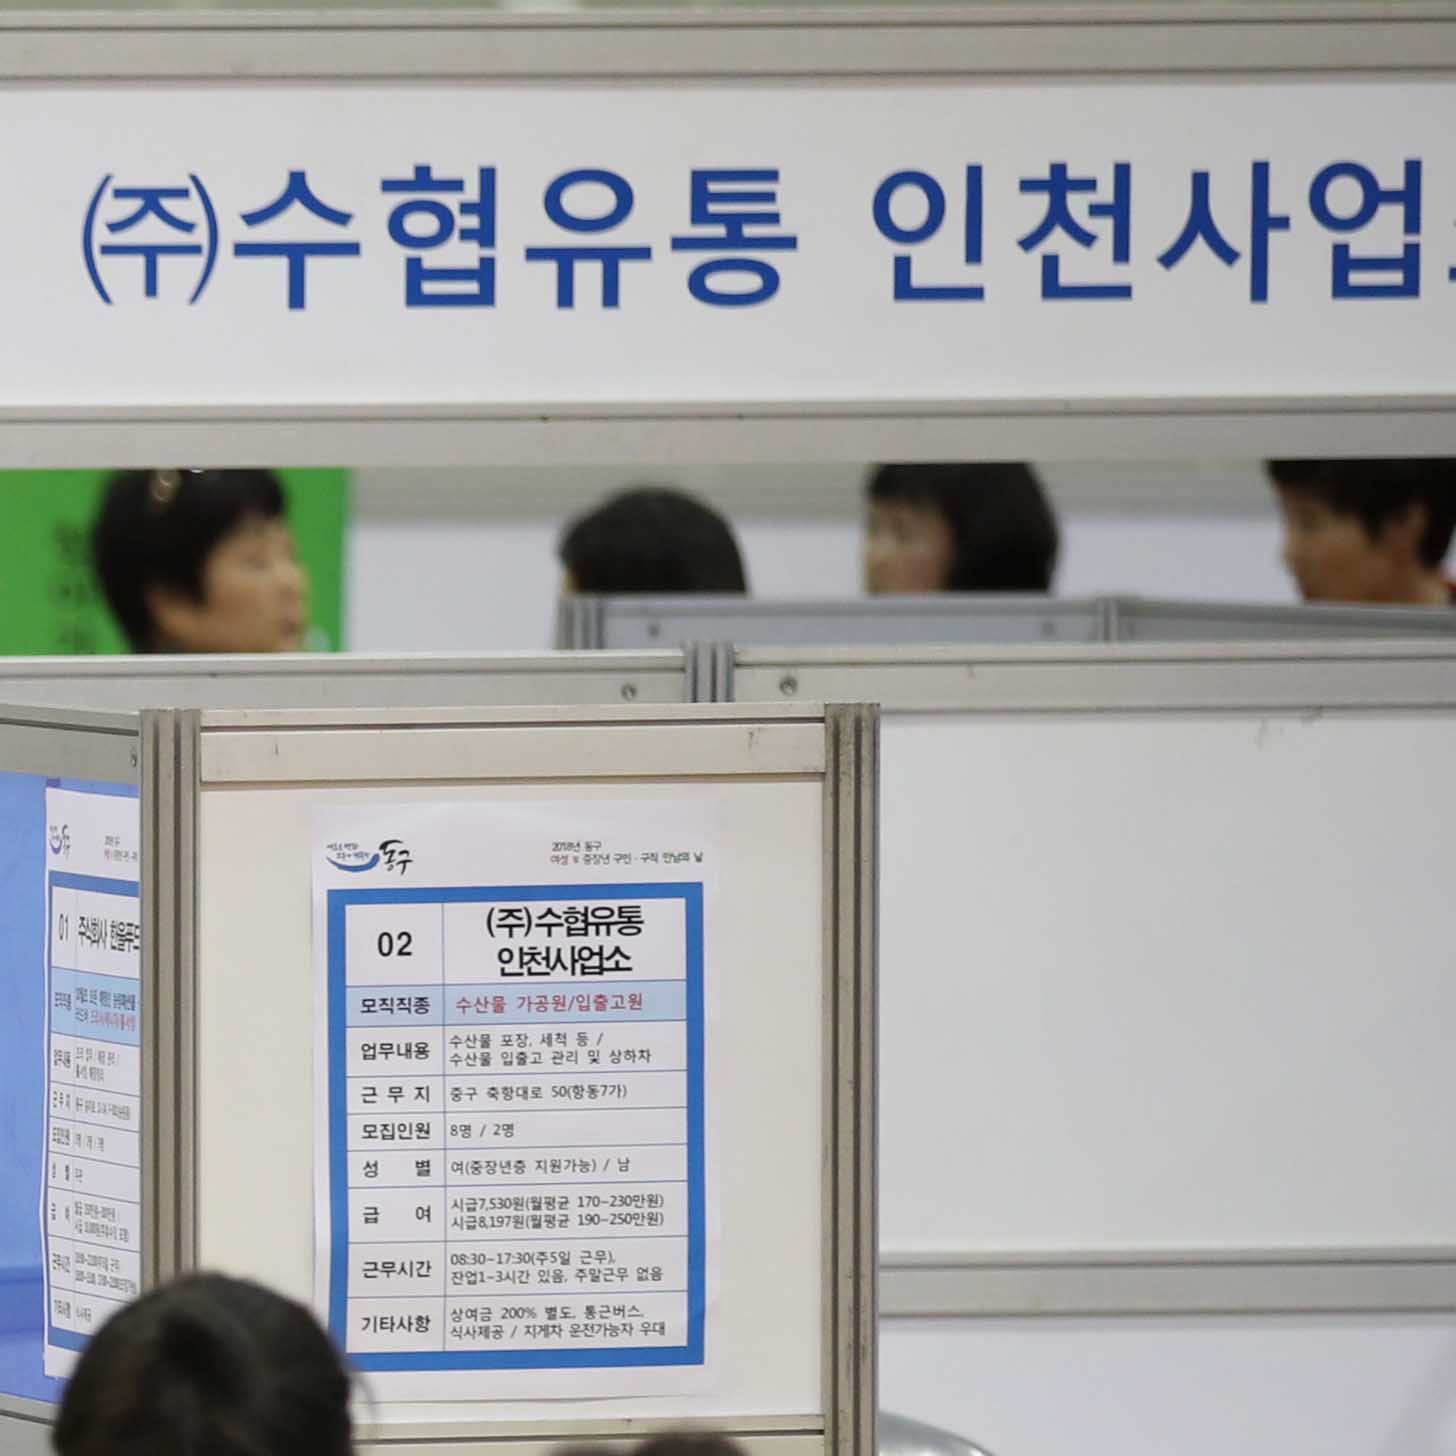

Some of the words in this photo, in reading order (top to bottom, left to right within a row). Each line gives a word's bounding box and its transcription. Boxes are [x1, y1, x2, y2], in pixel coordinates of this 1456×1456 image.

[870, 158, 1456, 306] 인천사업
[59, 913, 68, 941] 01
[487, 905, 643, 939] (주)수협유통
[378, 933, 412, 956] 02
[498, 946, 632, 977] 인천사업소
[456, 996, 507, 1013] 수산물
[518, 994, 643, 1011] 가공원/입출고원
[449, 1034, 491, 1049] 수산물
[540, 1033, 567, 1047] 세척
[576, 1032, 589, 1047] 등
[596, 1033, 604, 1045] /
[361, 1042, 430, 1060] 업무내용
[449, 1052, 492, 1067] 수산물
[501, 1051, 543, 1066] 입출고
[552, 1051, 578, 1065] 관리
[609, 1049, 651, 1064] 상하차
[361, 1087, 378, 1103] 근
[388, 1087, 405, 1103] 무
[414, 1086, 430, 1103] 지
[450, 1087, 478, 1102] 중구
[362, 1122, 430, 1140] 모집인원
[450, 1124, 472, 1138] 8명
[480, 1124, 487, 1137] /
[493, 1124, 514, 1137] 2명
[536, 1159, 596, 1173] 지원가능)
[603, 1160, 610, 1172] /
[618, 1158, 630, 1173] 남
[362, 1207, 379, 1223] 급
[415, 1205, 431, 1223] 여
[362, 1261, 431, 1278] 근무시간
[575, 1267, 628, 1283] 주말근무
[637, 1266, 663, 1282] 없음
[362, 1315, 430, 1333] 기타사항
[451, 1307, 492, 1323] 상여금
[501, 1307, 537, 1319] 200%
[451, 1325, 504, 1340] 식사제공
[511, 1325, 516, 1338] /
[641, 1321, 665, 1336] 우대
